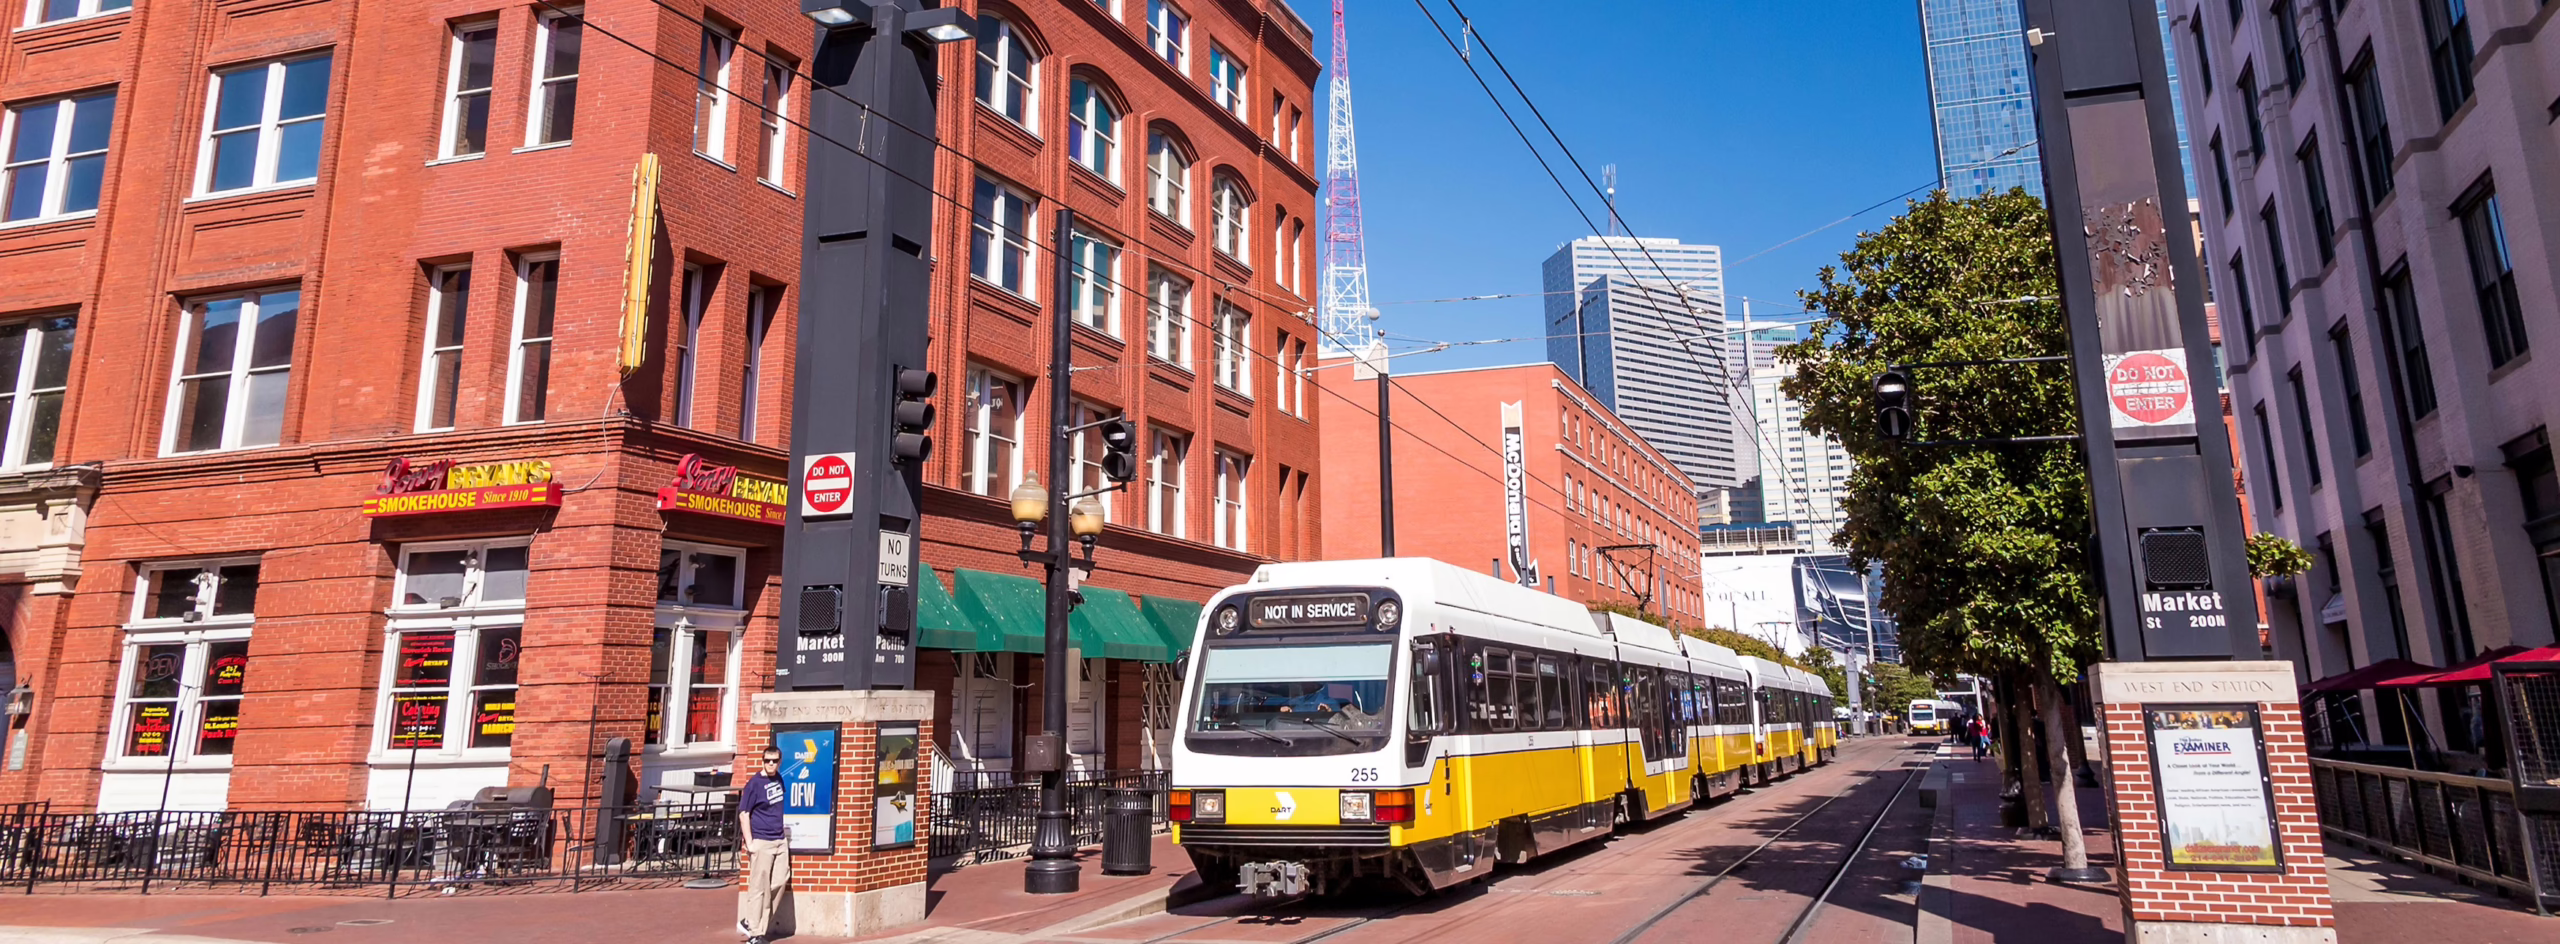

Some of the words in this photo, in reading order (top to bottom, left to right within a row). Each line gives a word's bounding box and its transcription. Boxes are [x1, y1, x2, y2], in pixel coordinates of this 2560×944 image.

[2115, 367, 2139, 382] DO
[2142, 365, 2177, 381] NOT
[2126, 396, 2177, 411] ENTER
[376, 457, 456, 495] Sonny
[448, 460, 552, 490] BRYAN'S
[671, 453, 738, 496] Sonny
[812, 467, 825, 477] DO
[828, 465, 846, 476] NOT
[377, 491, 477, 514] SMOKEHOUSE
[482, 491, 507, 504] Since
[508, 490, 529, 502] 1910
[814, 492, 841, 503] ENTER
[687, 493, 762, 519] SMOKEHOUSE
[765, 507, 783, 520] Since
[887, 539, 902, 556] NO
[880, 562, 907, 579] TURNS
[1264, 605, 1288, 619] NOT
[1291, 604, 1303, 618] IN
[1307, 602, 1356, 618] SERVICE
[2142, 592, 2223, 612] Market
[2146, 616, 2162, 629] St
[2189, 615, 2226, 628] 200N
[796, 634, 845, 651] Market
[875, 635, 906, 651] Pacific
[796, 654, 806, 664] St
[822, 652, 845, 663] 300N
[875, 653, 885, 664] Ave
[894, 654, 905, 664] 700
[2123, 681, 2165, 693] WEST
[2173, 681, 2204, 693] END
[2212, 680, 2275, 693] STATION
[815, 704, 853, 717] STATION
[2173, 742, 2231, 752] EXAMINER
[798, 765, 809, 779] to
[1351, 767, 1379, 782] 255
[790, 782, 816, 807] DFW
